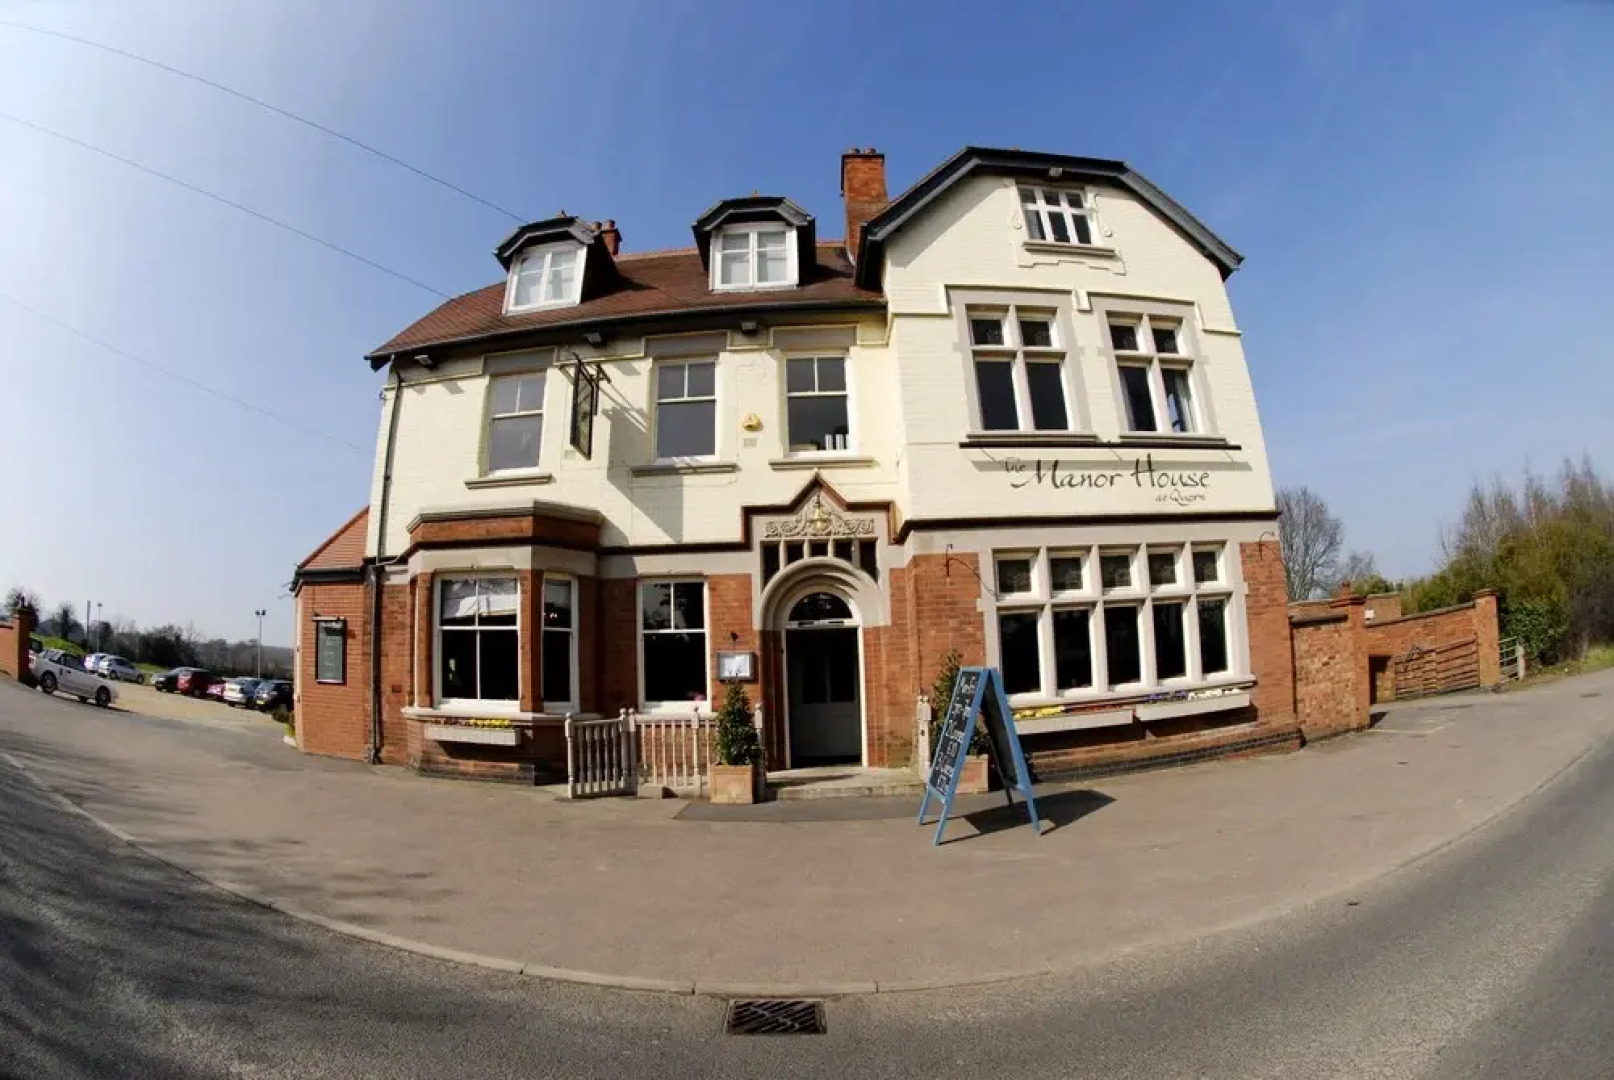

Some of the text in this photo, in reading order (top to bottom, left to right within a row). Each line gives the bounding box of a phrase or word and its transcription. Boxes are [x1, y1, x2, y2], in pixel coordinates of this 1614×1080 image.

[1004, 453, 1210, 488] The Manor House
[1155, 489, 1206, 507] at Quorn
